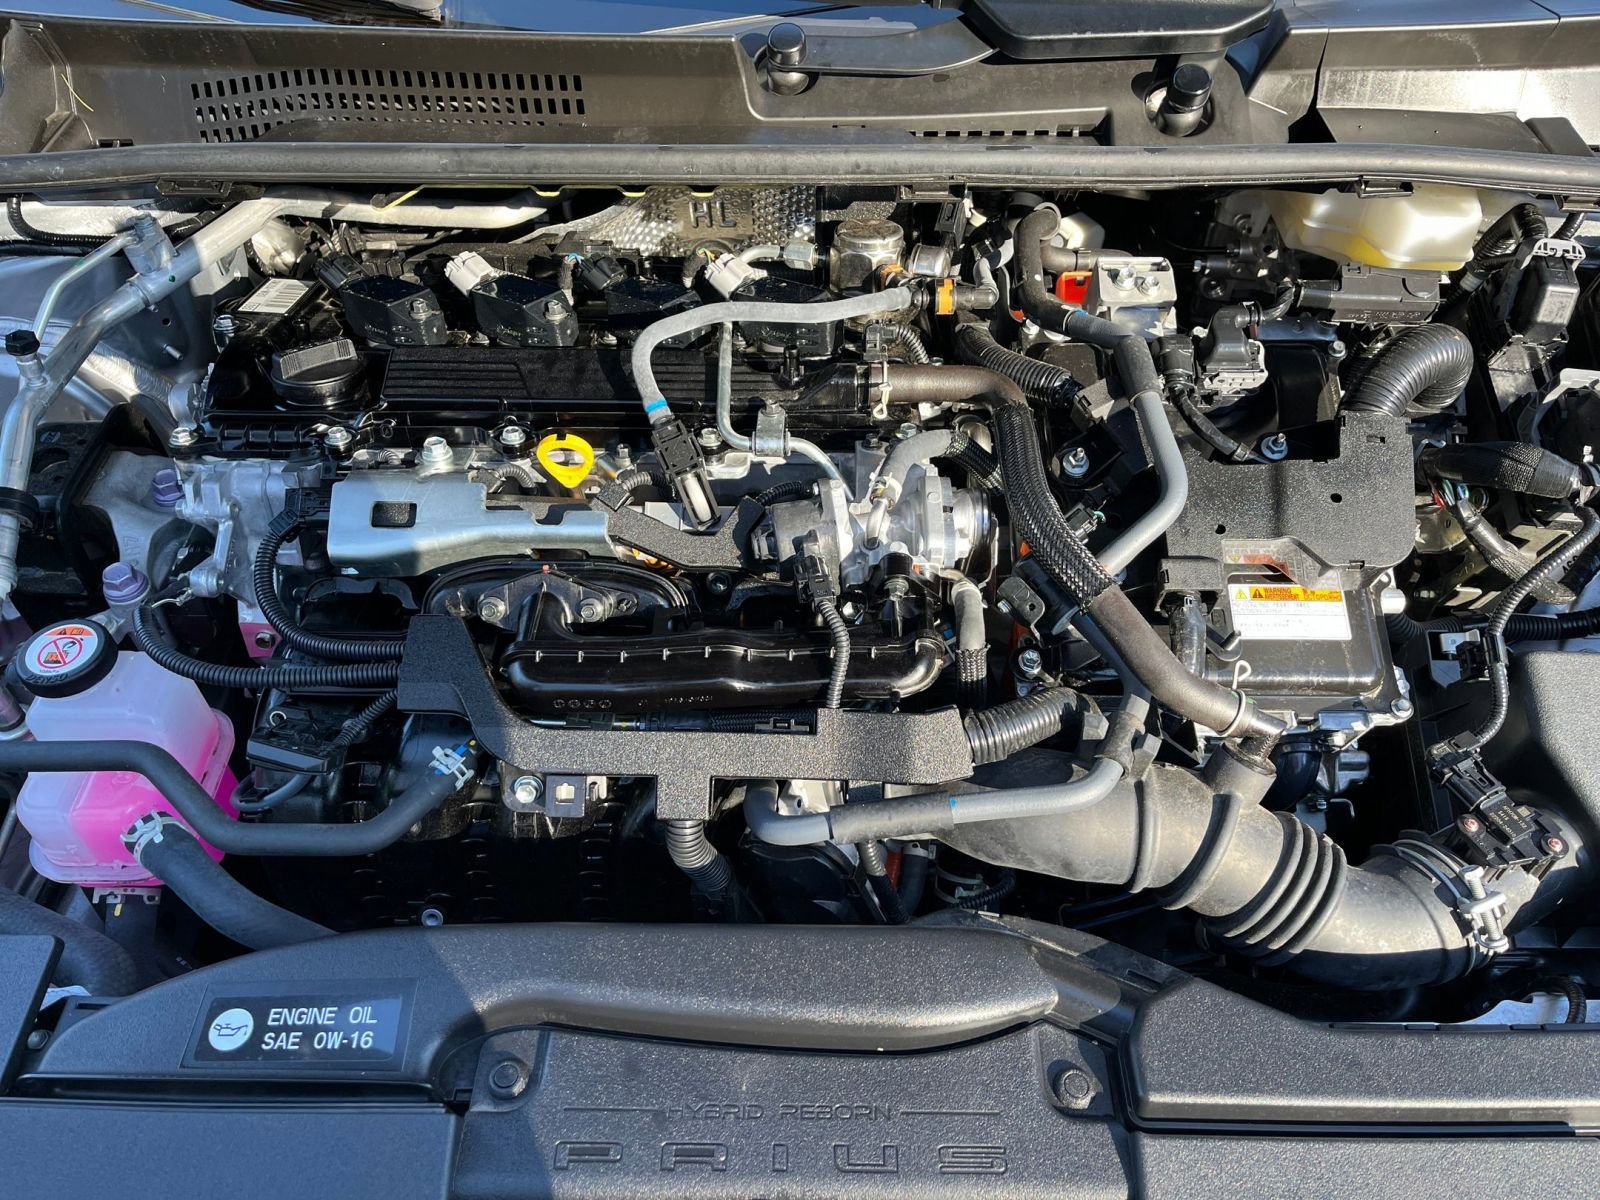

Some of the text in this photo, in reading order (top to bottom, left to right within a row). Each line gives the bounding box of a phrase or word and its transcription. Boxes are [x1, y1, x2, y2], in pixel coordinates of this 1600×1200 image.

[267, 1006, 378, 1026] ENGINE OIL
[261, 1031, 374, 1050] SAE 0W-16
[667, 1103, 892, 1122] HYBRID REBORN
[553, 1139, 1008, 1175] PRIUS
